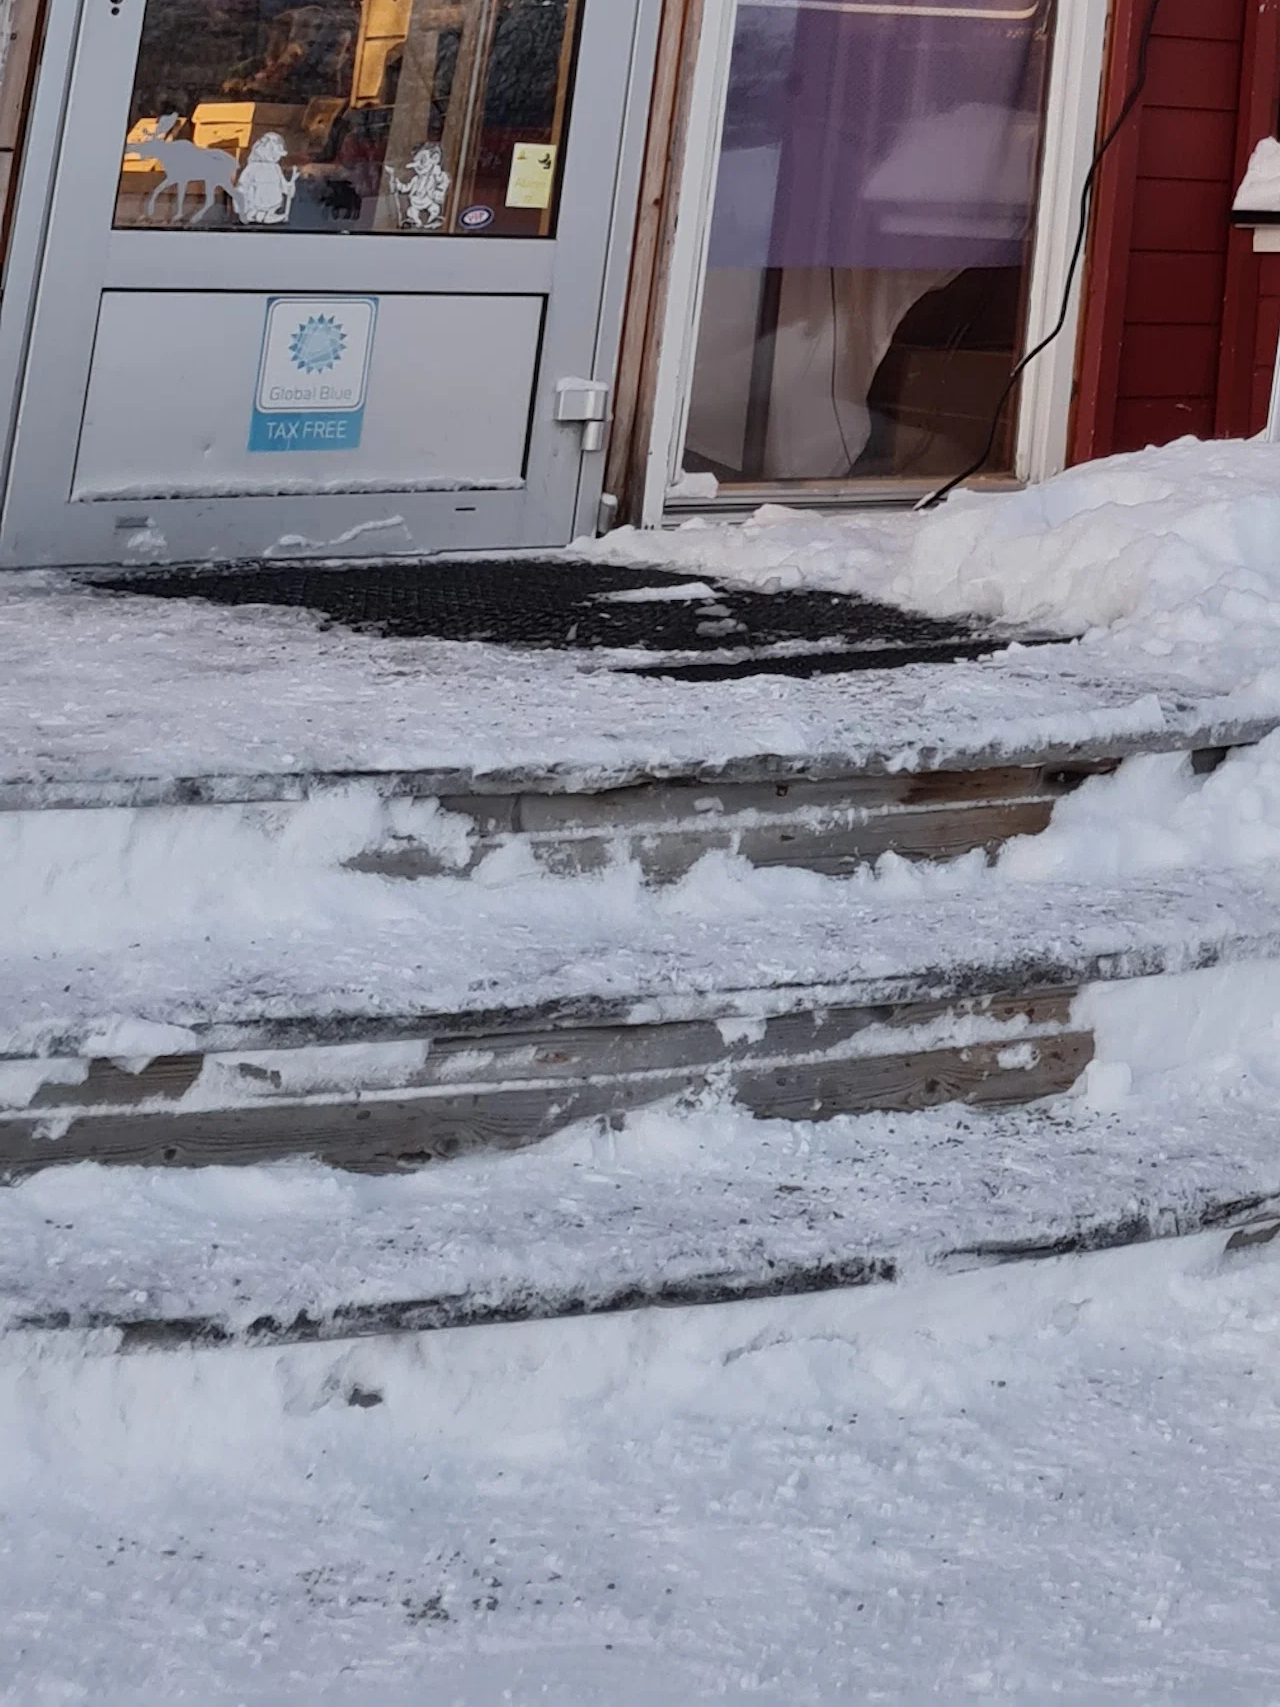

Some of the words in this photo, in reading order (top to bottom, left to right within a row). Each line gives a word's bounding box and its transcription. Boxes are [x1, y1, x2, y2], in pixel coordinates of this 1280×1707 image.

[269, 386, 317, 401] Global
[319, 386, 353, 400] Blue
[266, 421, 300, 440] TAX
[302, 420, 349, 439] FREE
